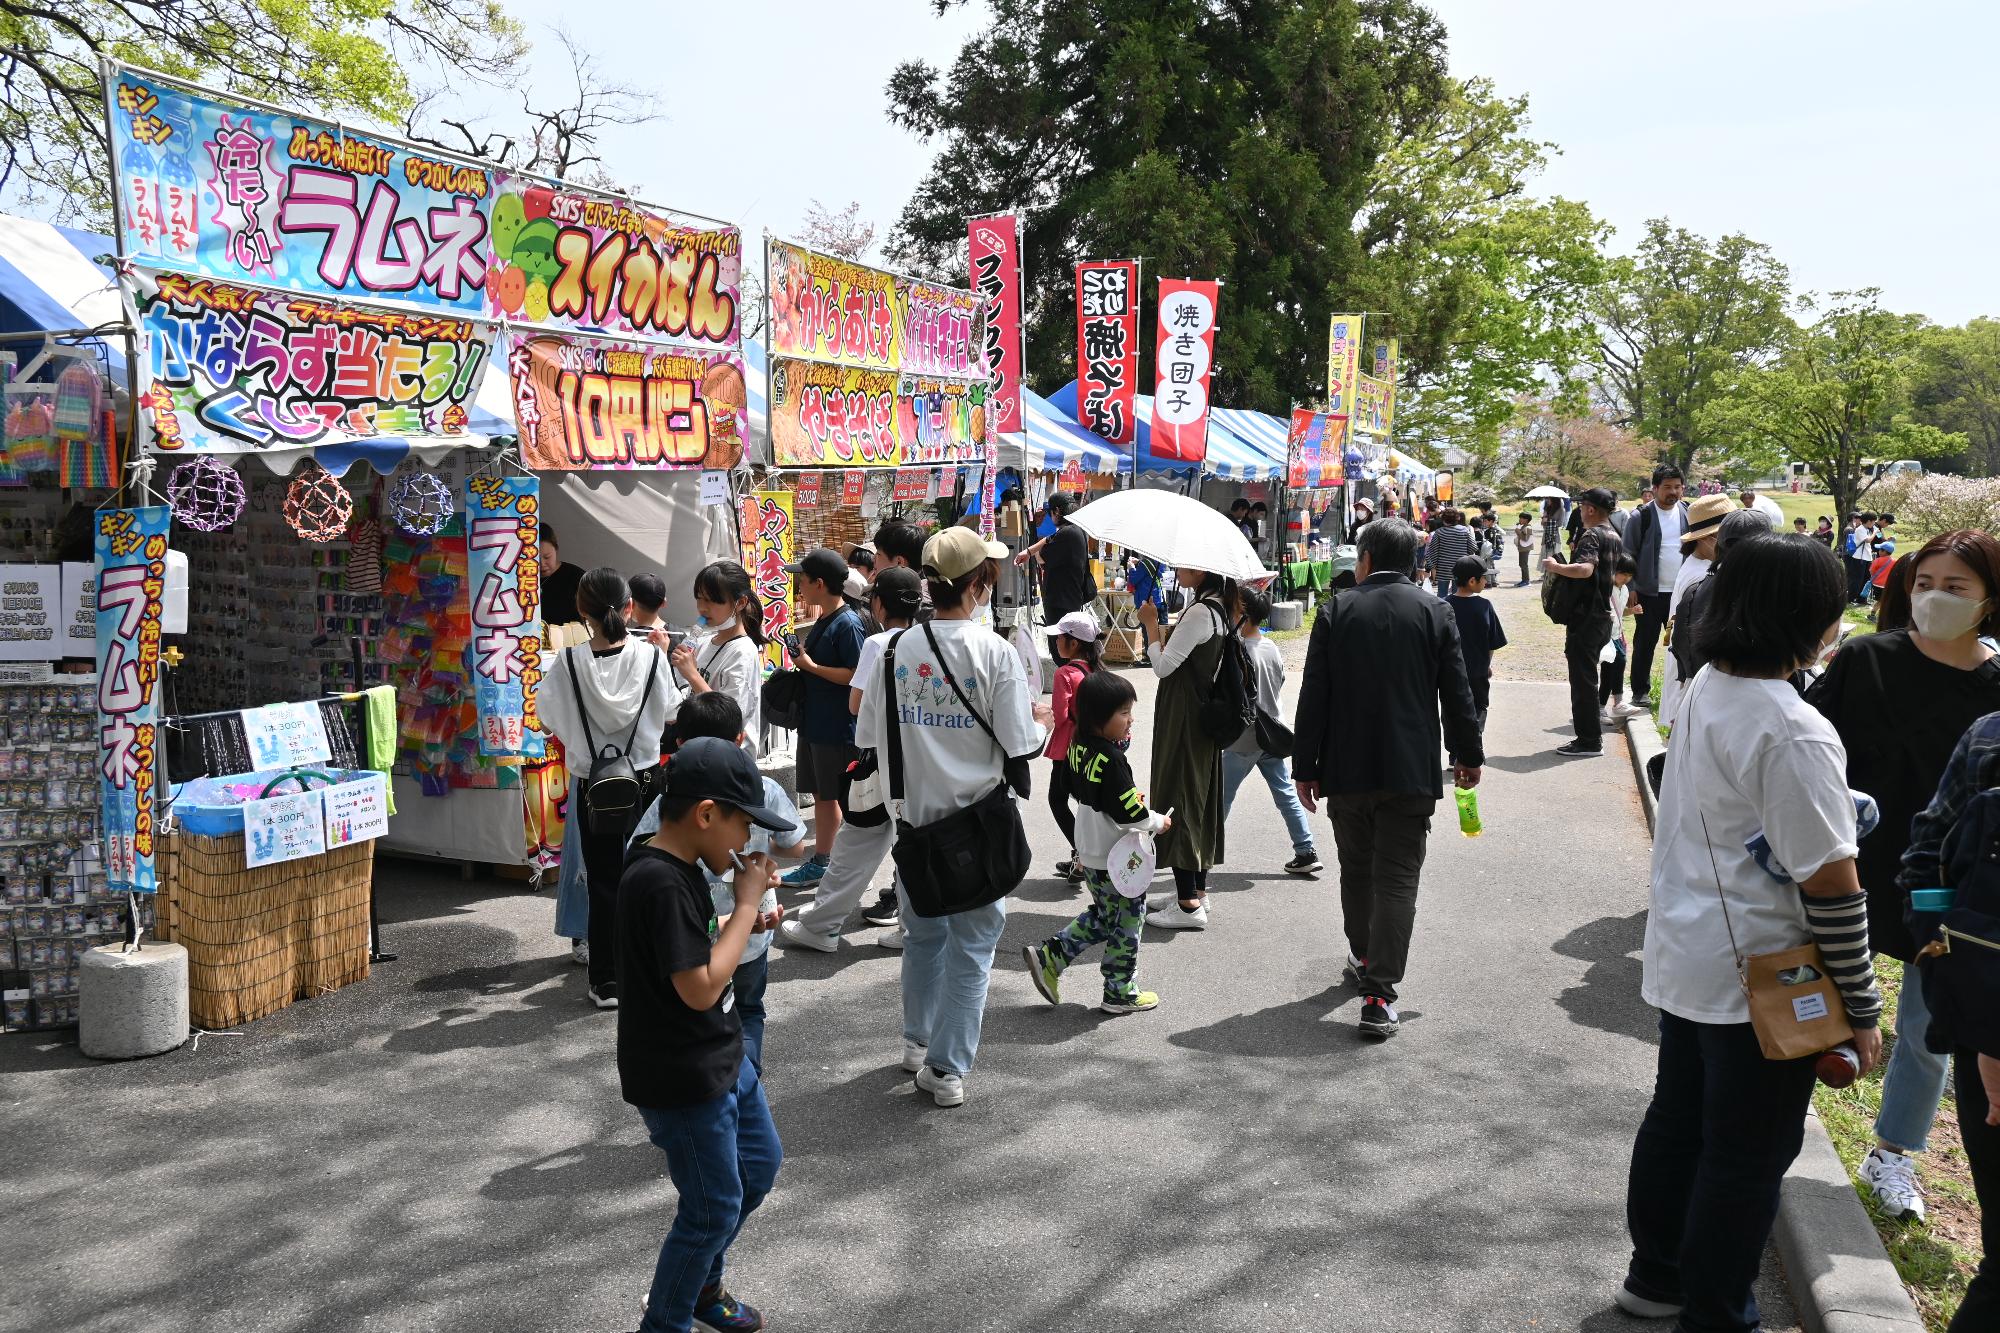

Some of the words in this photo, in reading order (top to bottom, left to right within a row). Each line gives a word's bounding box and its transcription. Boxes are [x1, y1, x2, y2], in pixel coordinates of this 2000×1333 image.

[117, 83, 160, 115] キン
[130, 115, 173, 146] キン
[403, 157, 489, 199] なつかしの味
[132, 178, 156, 247] ラムネ
[168, 187, 191, 253] ラムネ
[281, 165, 488, 301] ラムネ
[156, 274, 263, 311] 大人気!
[287, 299, 474, 343] ラッキーチャンス!
[799, 275, 894, 364] からあげ
[141, 300, 486, 408] かならず当たる!
[557, 345, 583, 372] SNS
[1165, 303, 1200, 414] 焼き団子
[508, 345, 540, 448] 大人気!
[556, 370, 710, 465] 10円パン
[799, 385, 897, 461] やきそば
[469, 476, 504, 496] キン
[480, 489, 515, 512] キン
[100, 511, 135, 536] キン
[110, 531, 145, 557] キン
[515, 494, 539, 622] めっちゃ冷たい!
[2, 597, 43, 610] 1回500円
[139, 535, 167, 704] めっちゃ冷たい!
[470, 516, 526, 684] ラムネ
[97, 565, 147, 790] ラムネ
[279, 720, 306, 731] 300円
[486, 716, 500, 746] ラムネ
[507, 716, 519, 746] ラムネ
[135, 722, 157, 855] なつかしの味
[278, 811, 305, 824] 300円
[109, 834, 120, 875] ラムネ
[123, 836, 134, 877] ラムネ
[284, 839, 313, 849] ブルーハワイ
